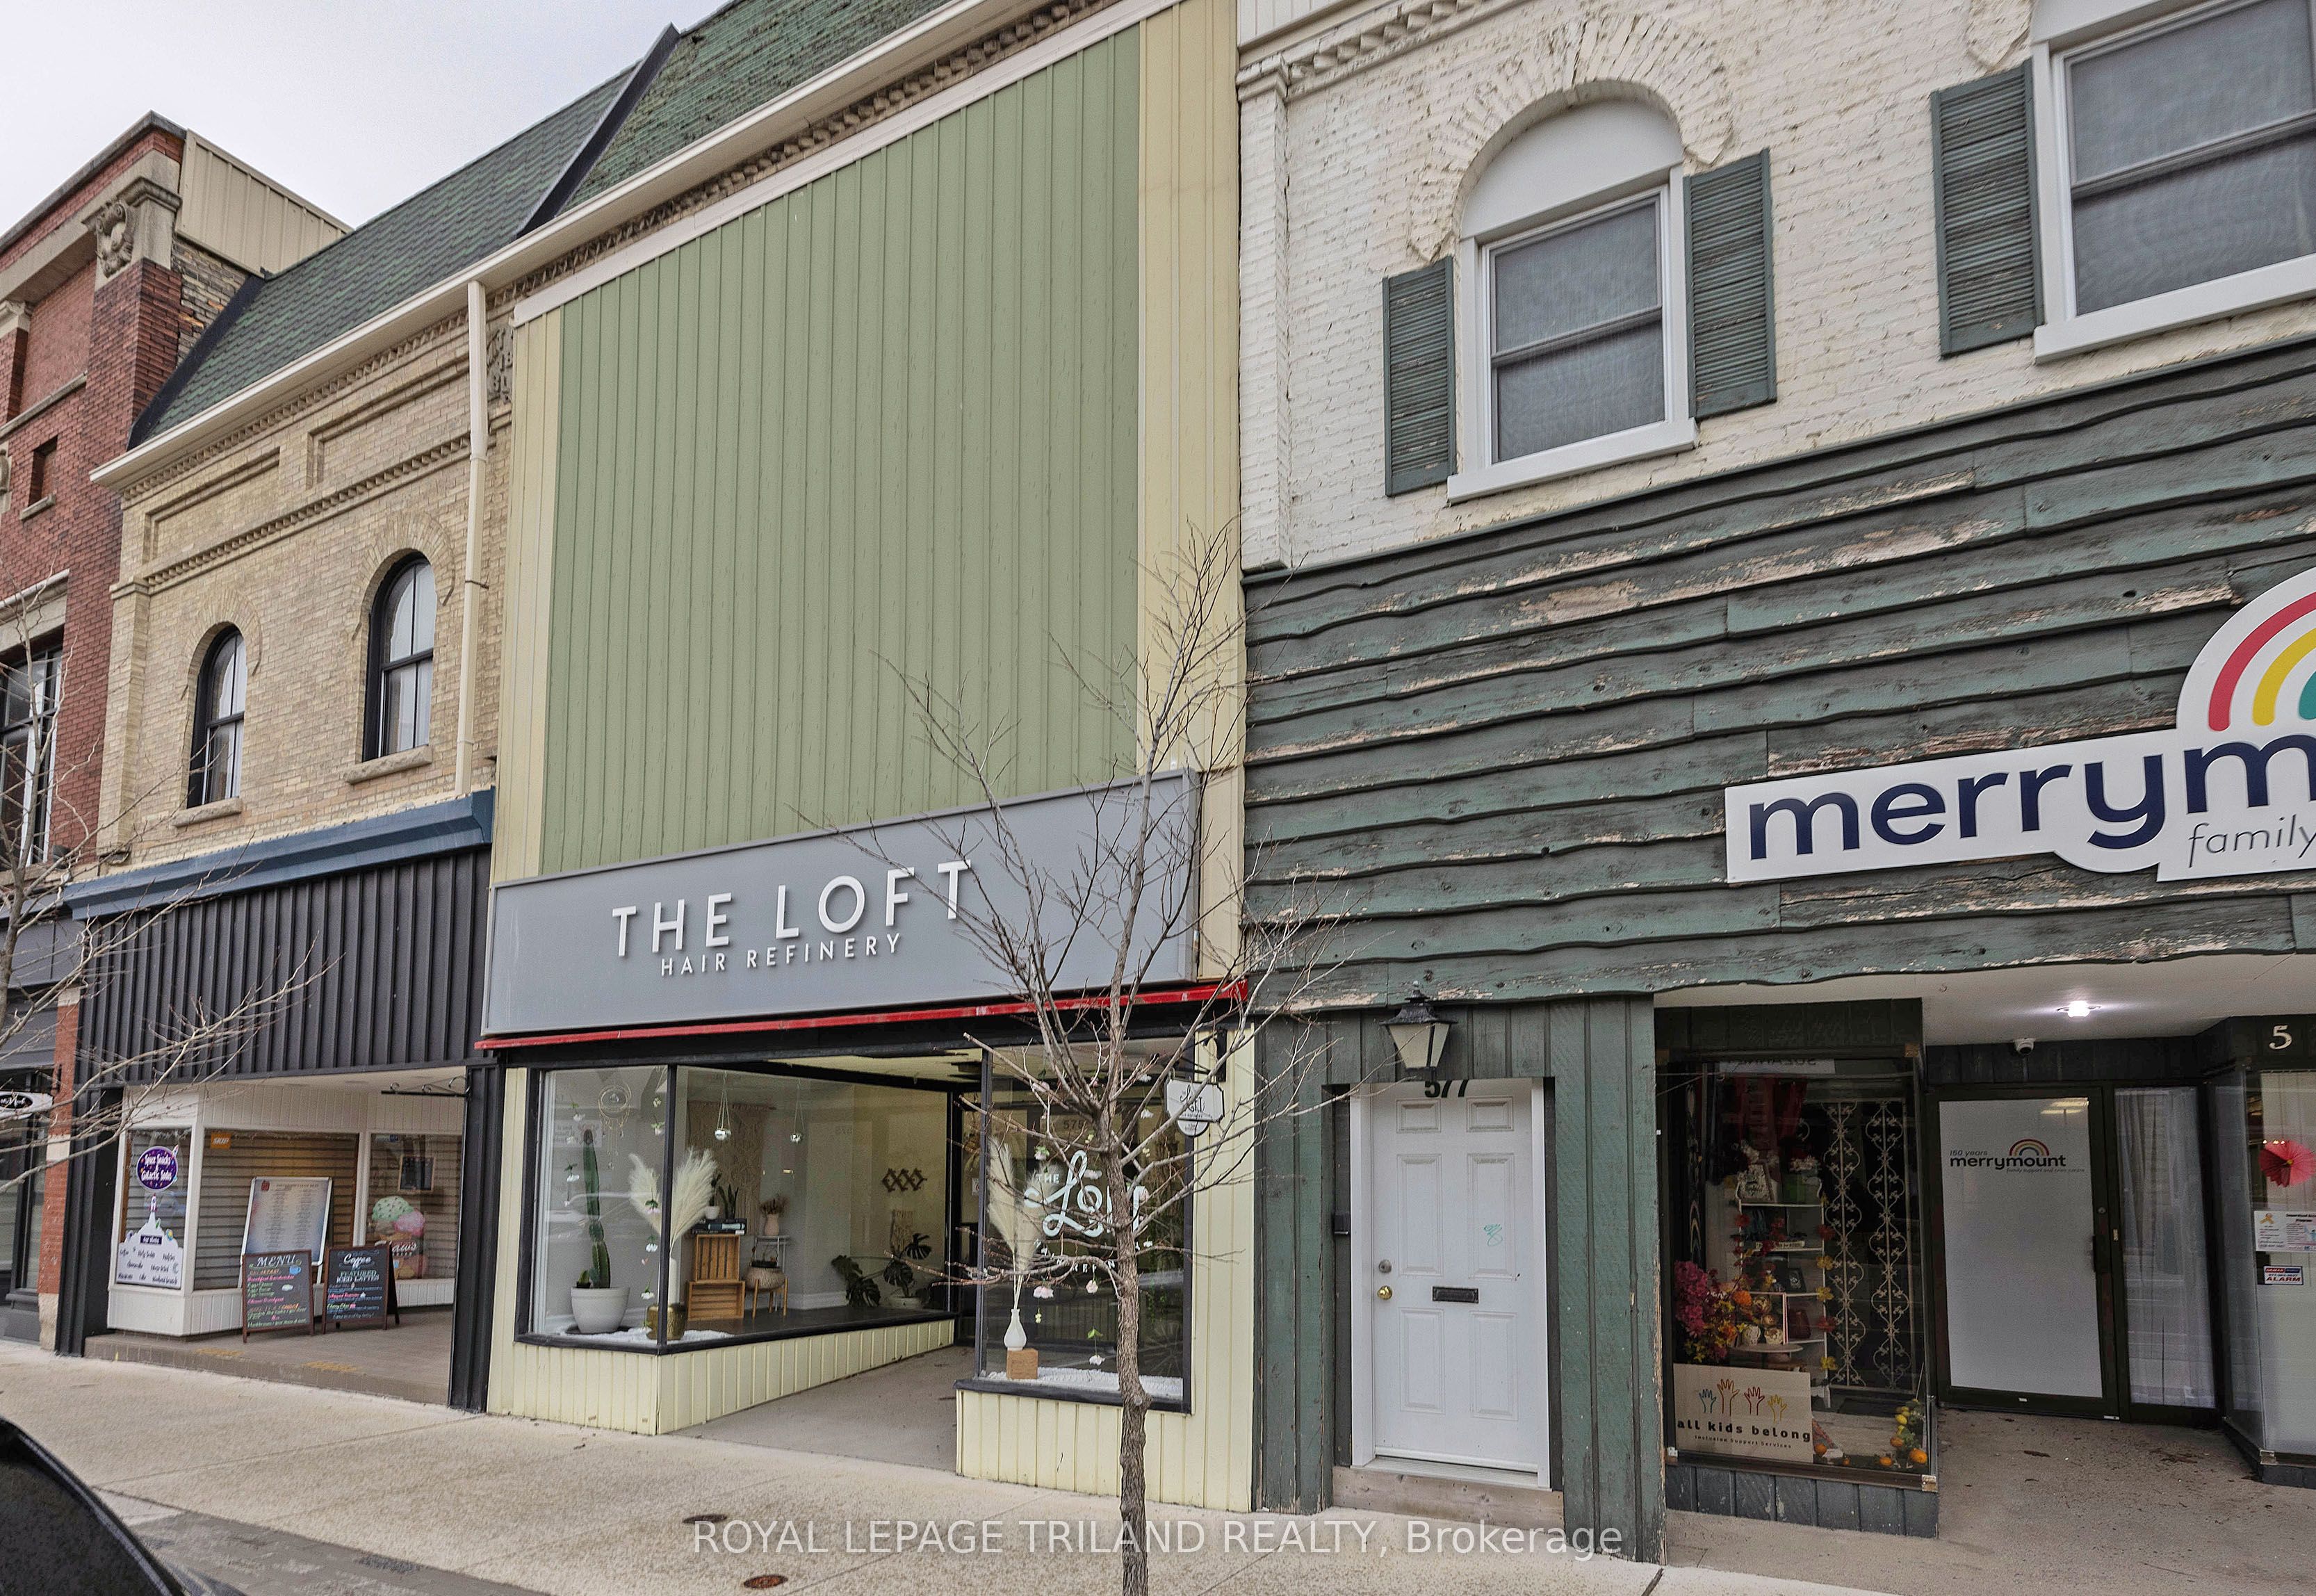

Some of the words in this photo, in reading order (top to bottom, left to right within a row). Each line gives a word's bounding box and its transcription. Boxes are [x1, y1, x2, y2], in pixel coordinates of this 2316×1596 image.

[2188, 814, 2316, 869] family
[612, 893, 732, 957] THE
[776, 859, 971, 940] LOFT
[661, 953, 726, 977] HAIR
[747, 932, 900, 968] REFINERY
[2269, 1025, 2292, 1050] 5
[1950, 1155, 2066, 1170] merrymount
[1036, 1173, 1060, 1184] THE
[257, 1254, 296, 1267] MENU
[343, 1253, 372, 1268] Coffee
[1677, 1419, 1701, 1430] all
[1707, 1422, 1743, 1434] kids
[1751, 1425, 1811, 1442] belong
[1761, 1441, 1792, 1449] Services
